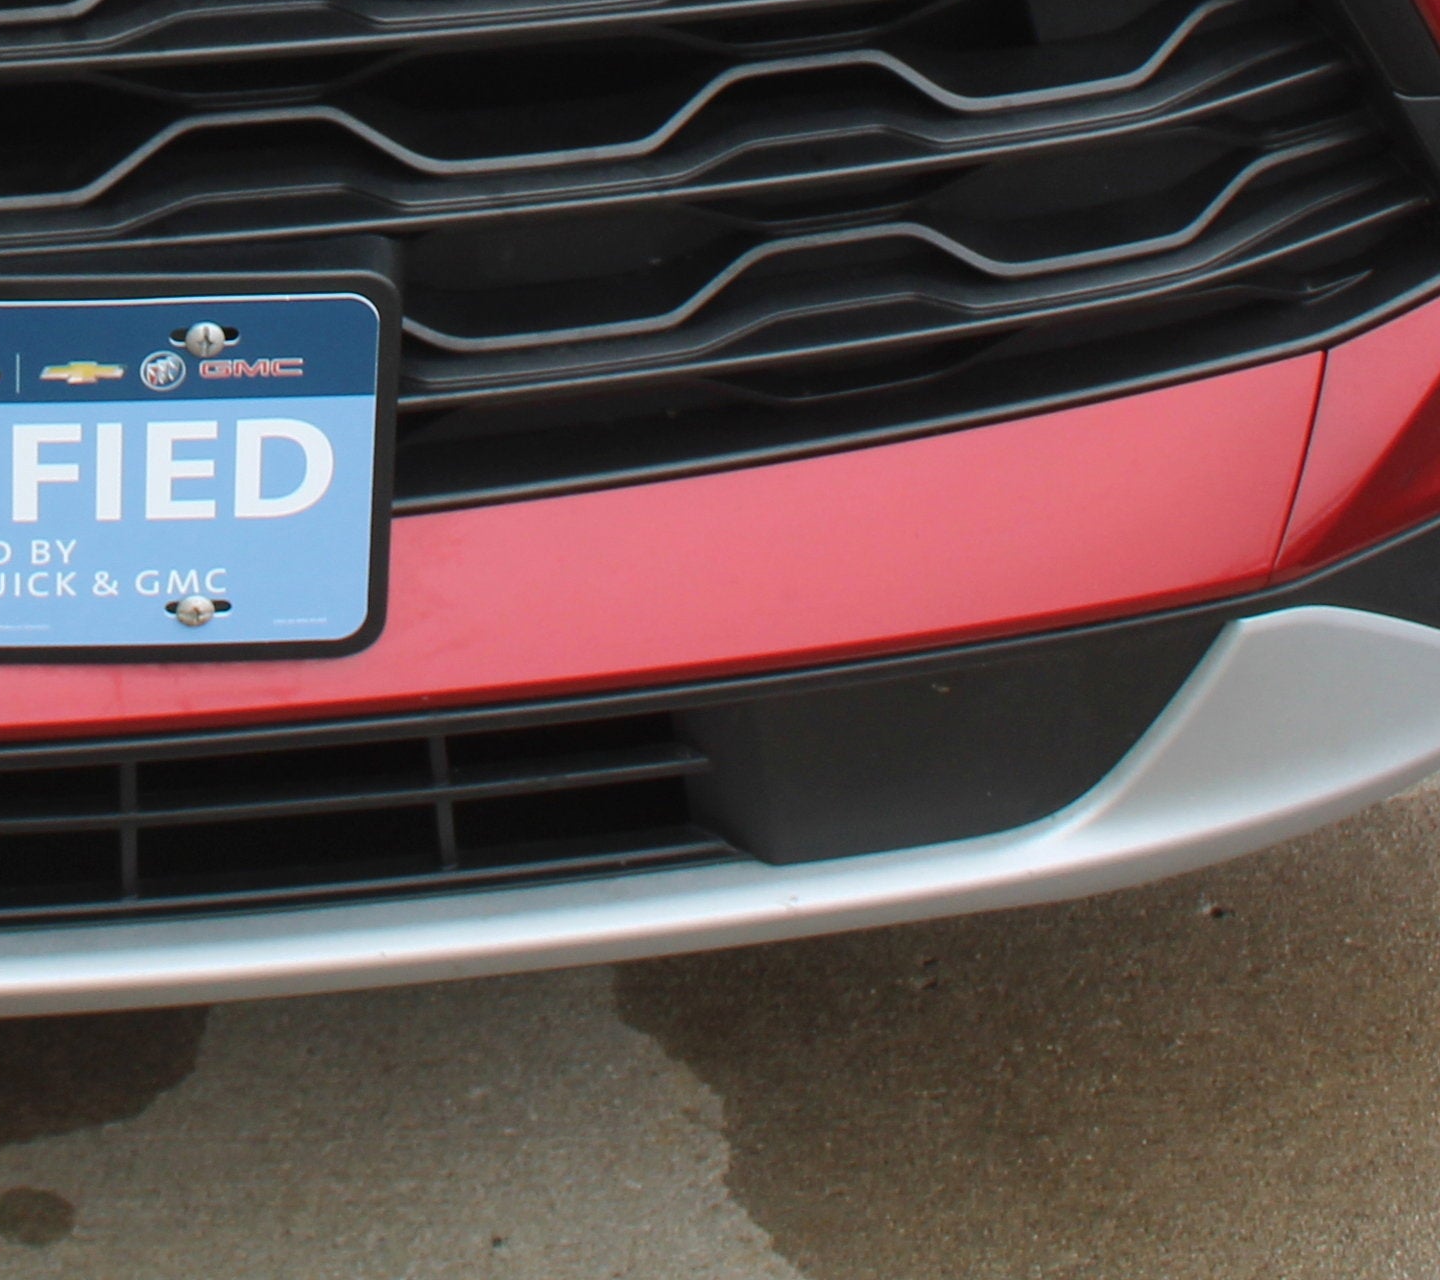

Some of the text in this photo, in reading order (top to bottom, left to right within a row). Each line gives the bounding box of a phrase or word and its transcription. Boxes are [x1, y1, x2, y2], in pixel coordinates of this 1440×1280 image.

[199, 357, 305, 380] GMC
[30, 539, 78, 565] BY
[92, 569, 120, 596] &
[134, 567, 229, 595] GMC
